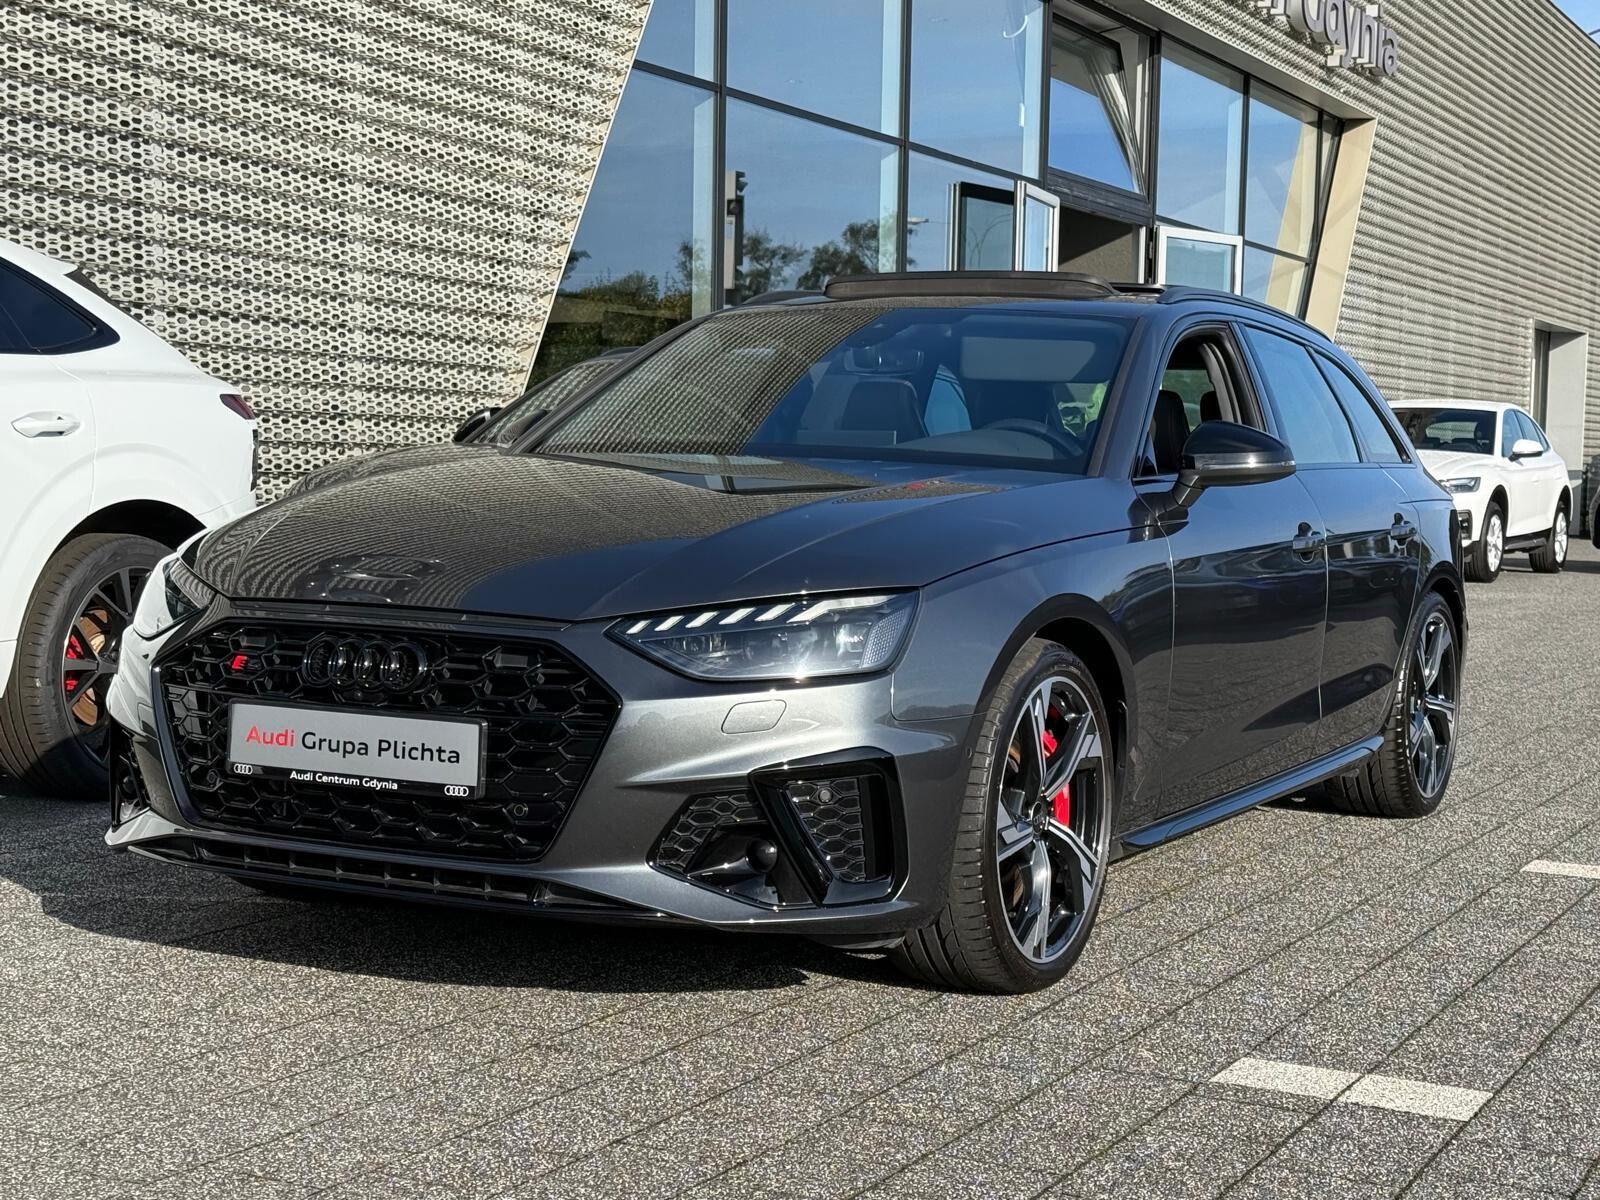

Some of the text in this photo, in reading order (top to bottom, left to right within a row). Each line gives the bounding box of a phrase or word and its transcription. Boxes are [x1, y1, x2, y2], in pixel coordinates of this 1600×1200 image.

[246, 725, 461, 764] Audi Grupa Plichta
[289, 770, 398, 791] Audi Centrum Gdynia
